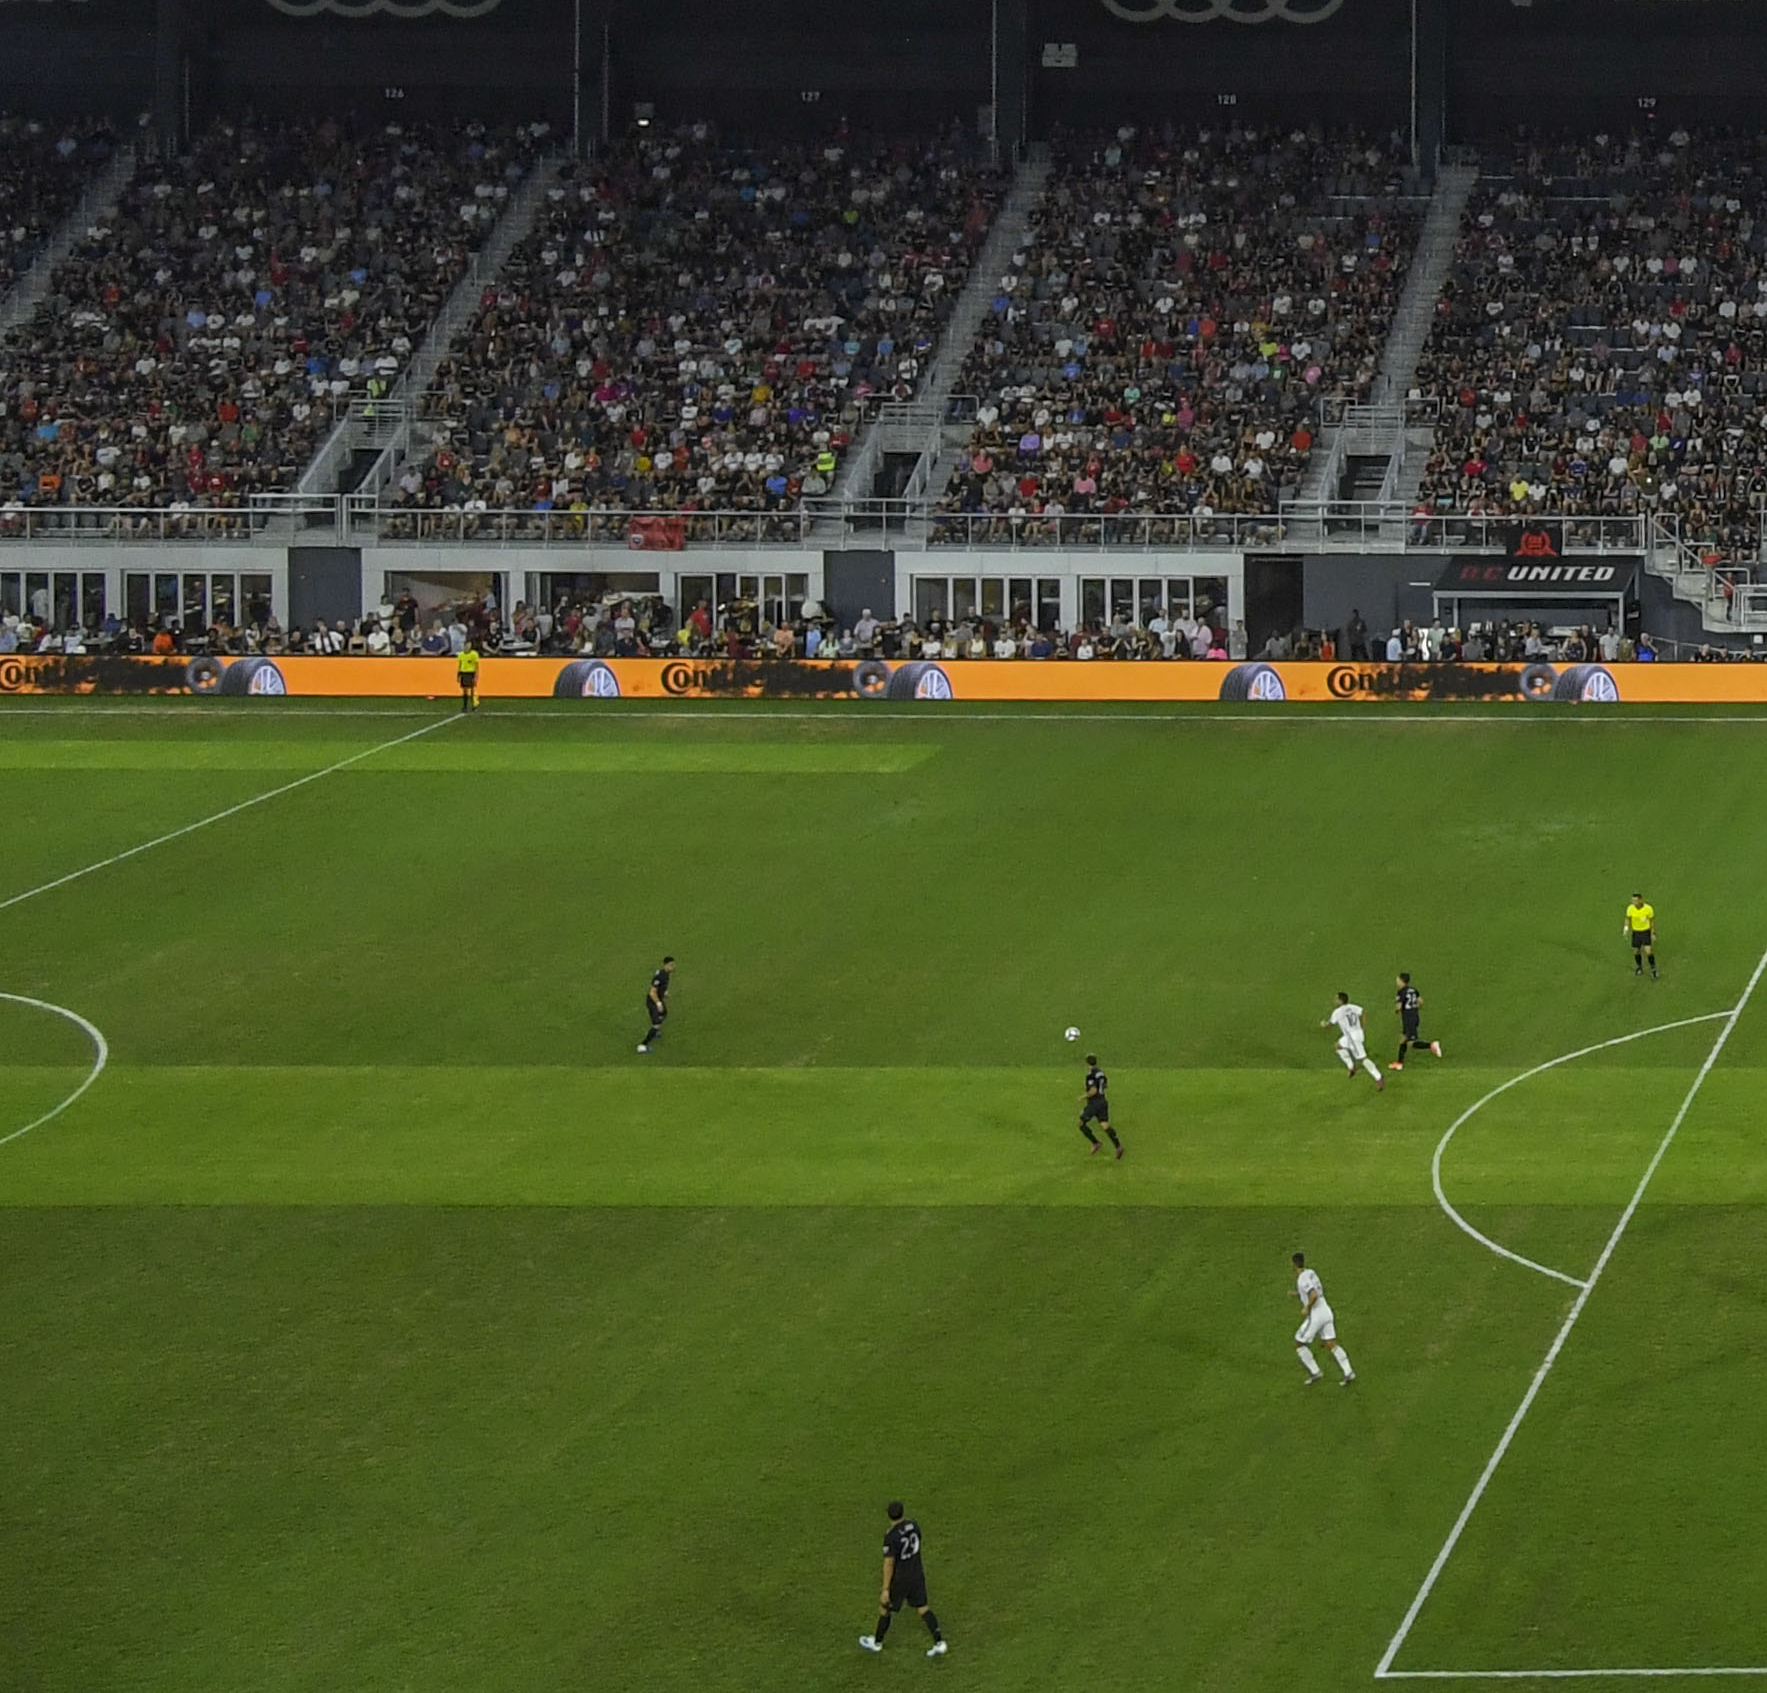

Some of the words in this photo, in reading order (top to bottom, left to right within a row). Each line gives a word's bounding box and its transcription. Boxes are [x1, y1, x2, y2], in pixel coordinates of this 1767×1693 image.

[801, 91, 820, 103] 127
[1507, 565, 1616, 581] UNITED
[900, 1532, 920, 1560] 29
